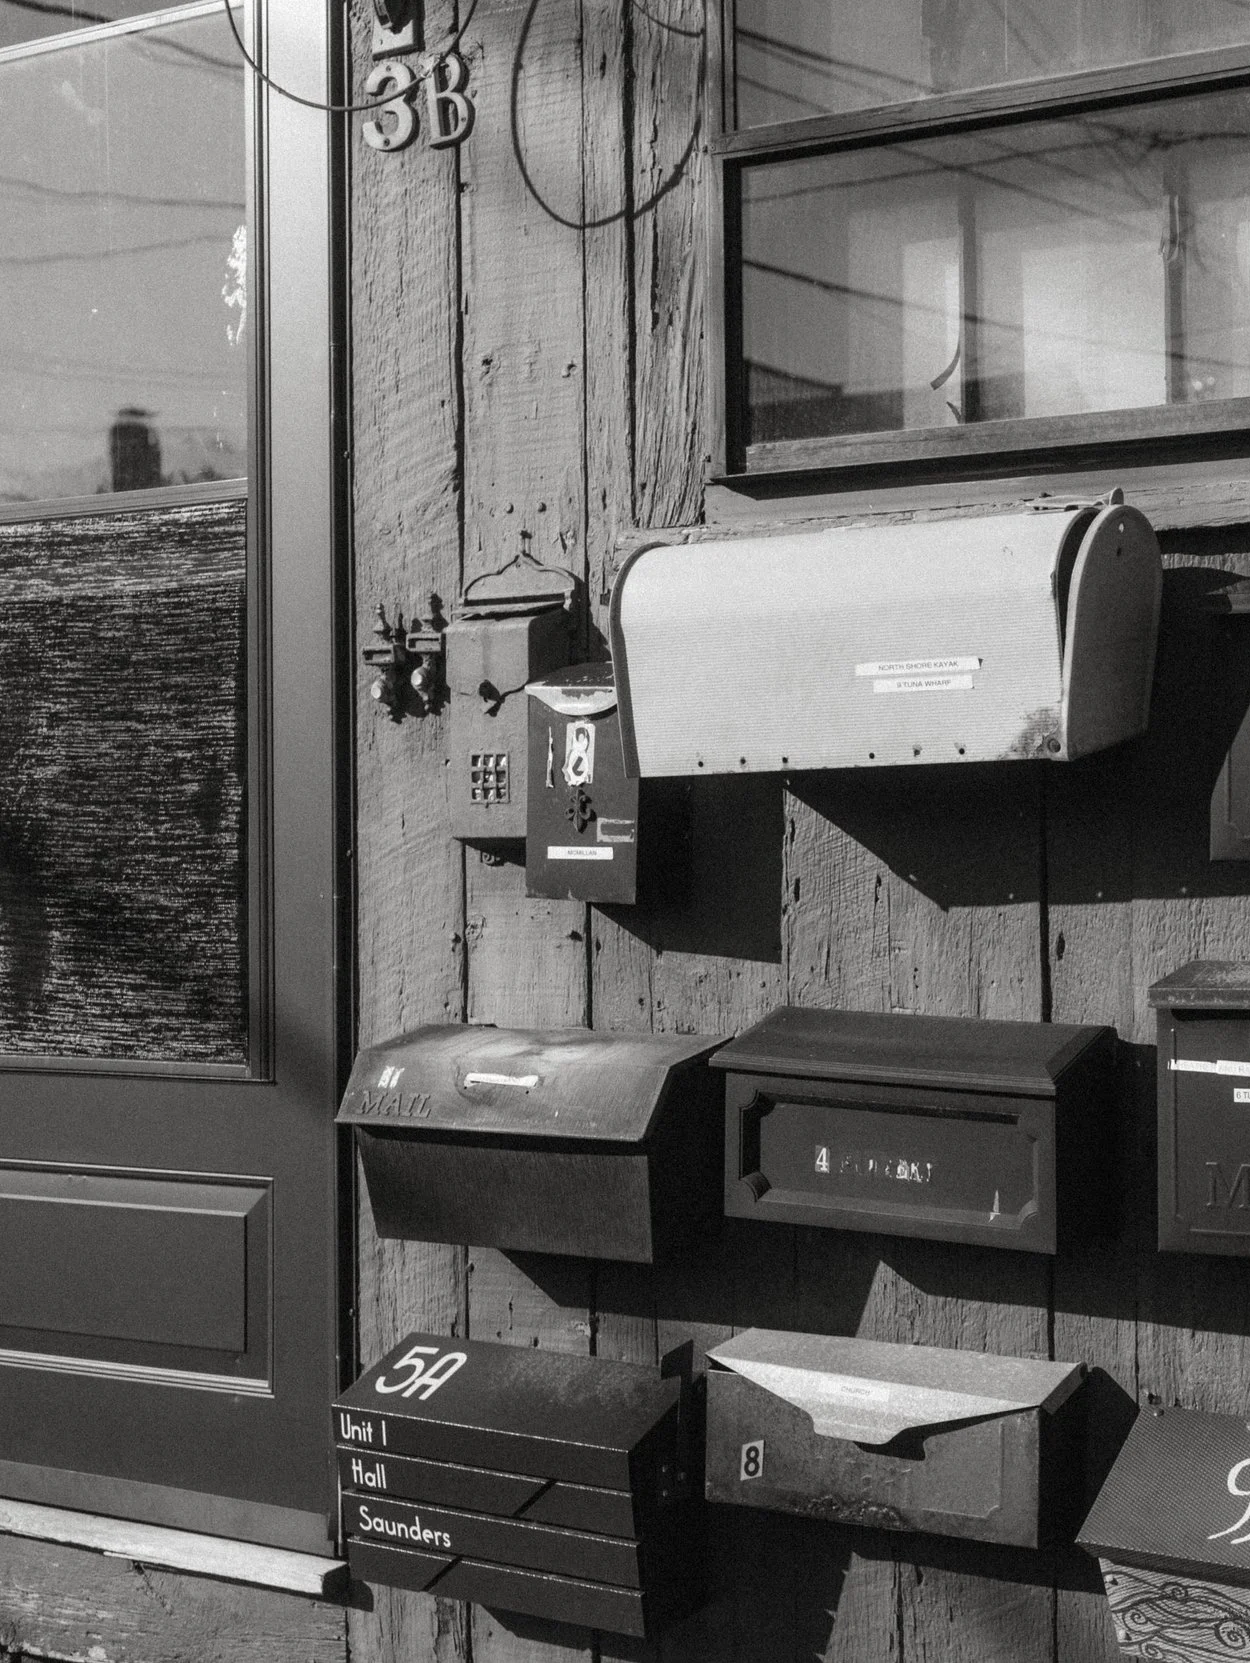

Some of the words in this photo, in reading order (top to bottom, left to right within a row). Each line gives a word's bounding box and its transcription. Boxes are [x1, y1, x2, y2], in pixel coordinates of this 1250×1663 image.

[362, 52, 470, 152] 3B
[878, 663, 904, 672] NORTH
[906, 661, 933, 671] SHORE
[934, 659, 959, 669] KAYAK
[903, 680, 923, 689] TUNA
[924, 678, 952, 688] WHARF
[360, 1090, 432, 1119] MAIL
[1236, 1091, 1242, 1100] 6
[815, 1146, 829, 1172] 4
[374, 1345, 468, 1400] 5A
[340, 1412, 373, 1443] Unit
[352, 1458, 387, 1489] Hall
[744, 1445, 760, 1478] 8
[359, 1504, 452, 1548] Saunders
